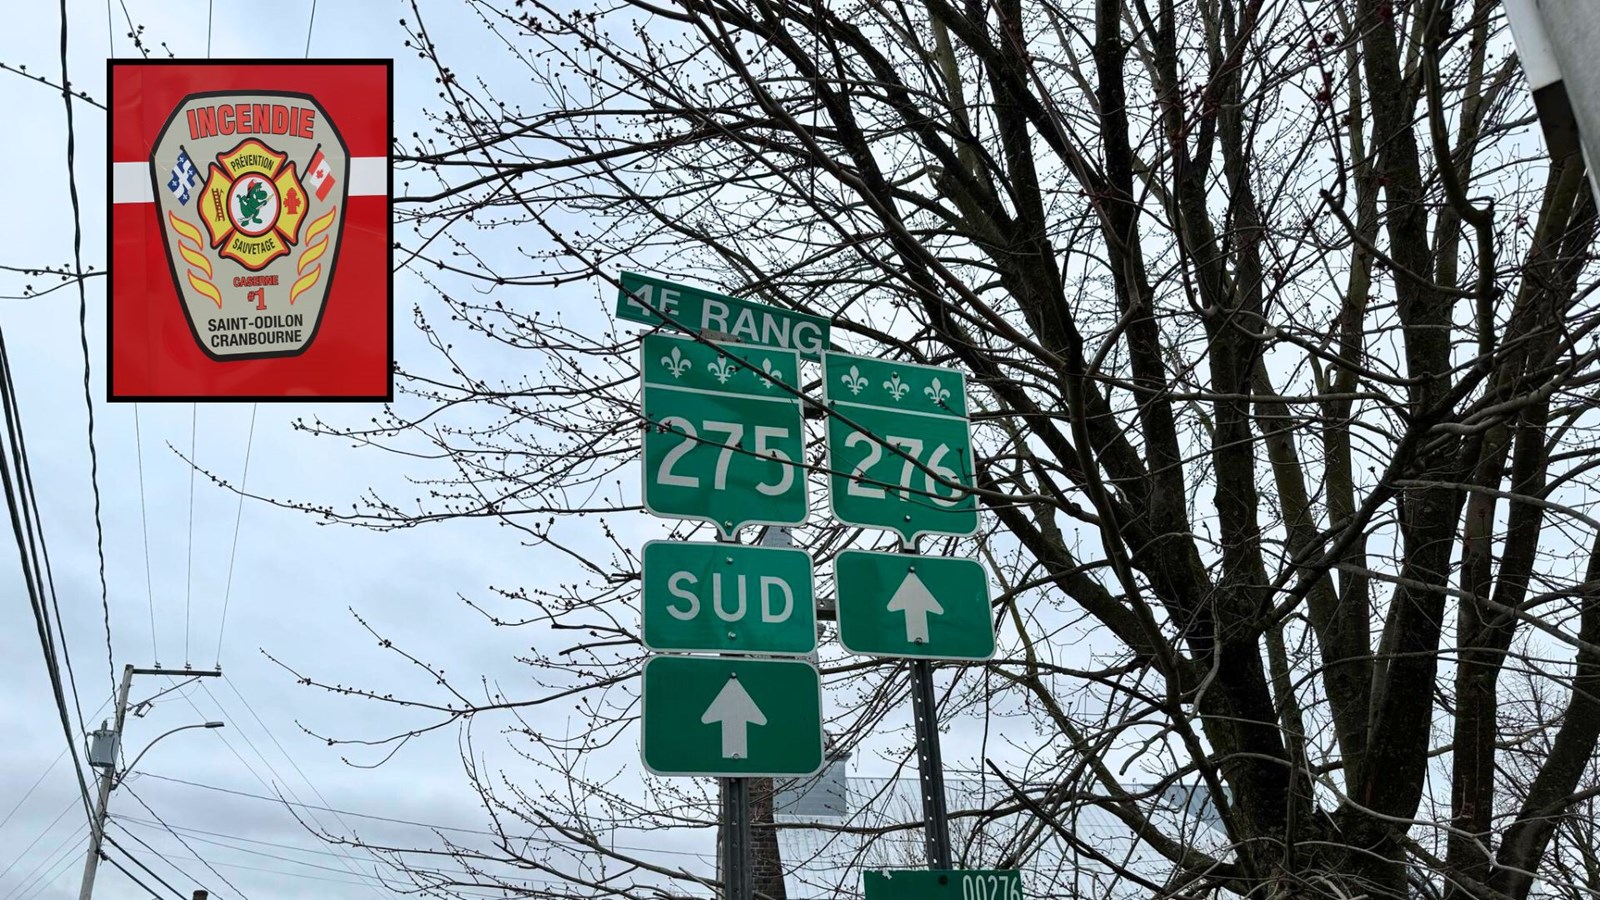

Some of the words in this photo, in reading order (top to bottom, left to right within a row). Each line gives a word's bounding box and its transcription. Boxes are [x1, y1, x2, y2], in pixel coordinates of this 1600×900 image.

[186, 104, 316, 140] INCENDIE
[231, 154, 275, 172] PRÉVENTION
[232, 238, 277, 255] SAUVETAGE
[233, 275, 279, 287] CASERNE
[247, 287, 267, 310] #1
[207, 314, 303, 332] SAINT-ODILON
[702, 298, 823, 354] RANG
[211, 330, 302, 348] CRANBOURNE
[656, 415, 795, 496] 275
[844, 430, 963, 507] 276
[665, 571, 794, 623] SUD
